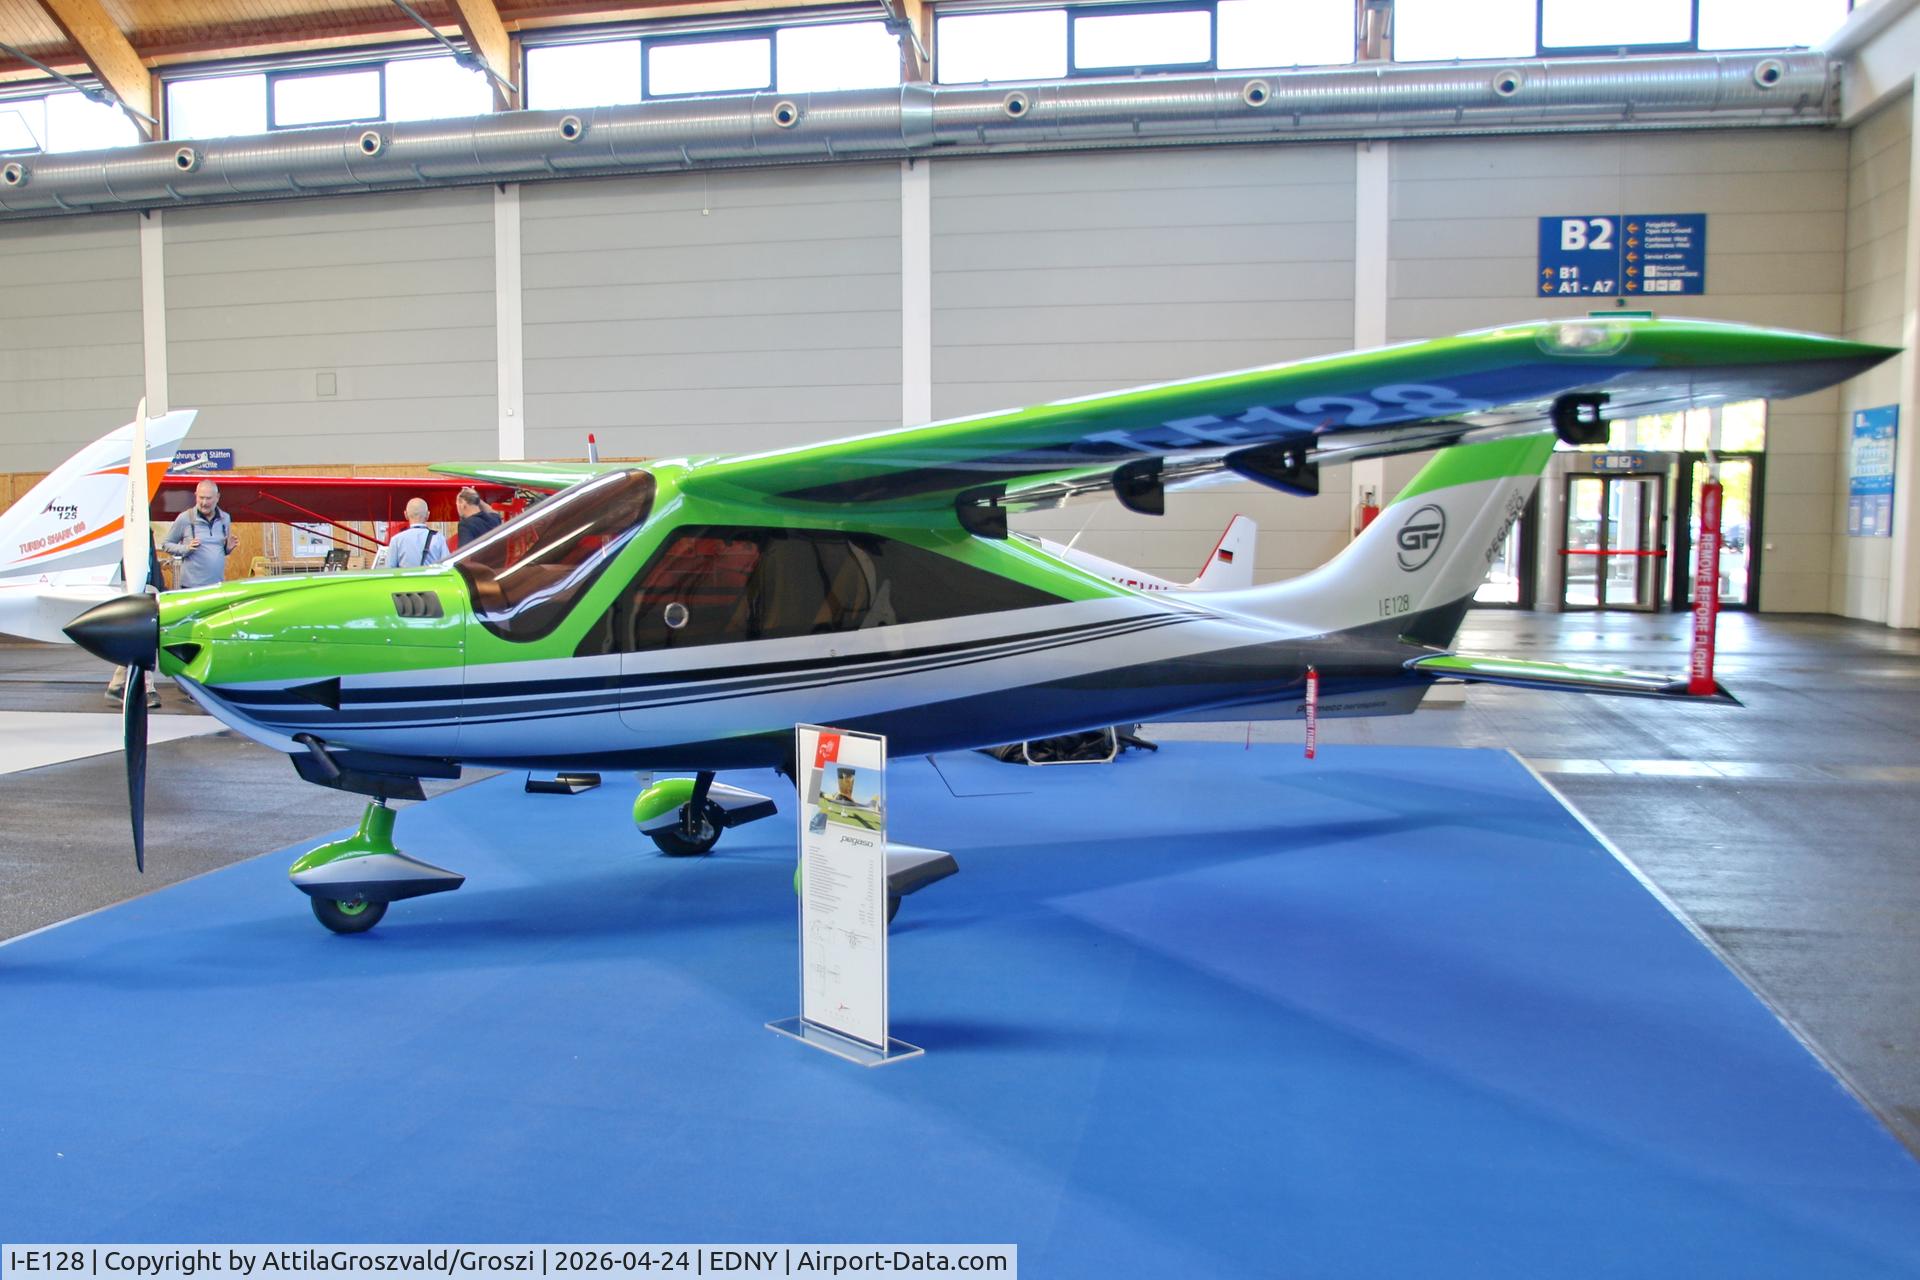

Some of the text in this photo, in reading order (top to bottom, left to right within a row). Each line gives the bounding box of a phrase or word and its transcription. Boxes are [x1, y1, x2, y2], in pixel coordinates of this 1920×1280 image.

[1561, 219, 1612, 250] B2
[1559, 267, 1579, 279] B1
[1558, 281, 1579, 293] A1
[1592, 281, 1614, 293] A7
[209, 451, 231, 459] Stätten
[58, 511, 77, 520] 125
[19, 537, 46, 555] TURBO
[47, 527, 74, 545] SHARK
[1698, 533, 1714, 582] REMOVE
[1695, 585, 1711, 632] BEFORE
[840, 835, 874, 848] pegaso
